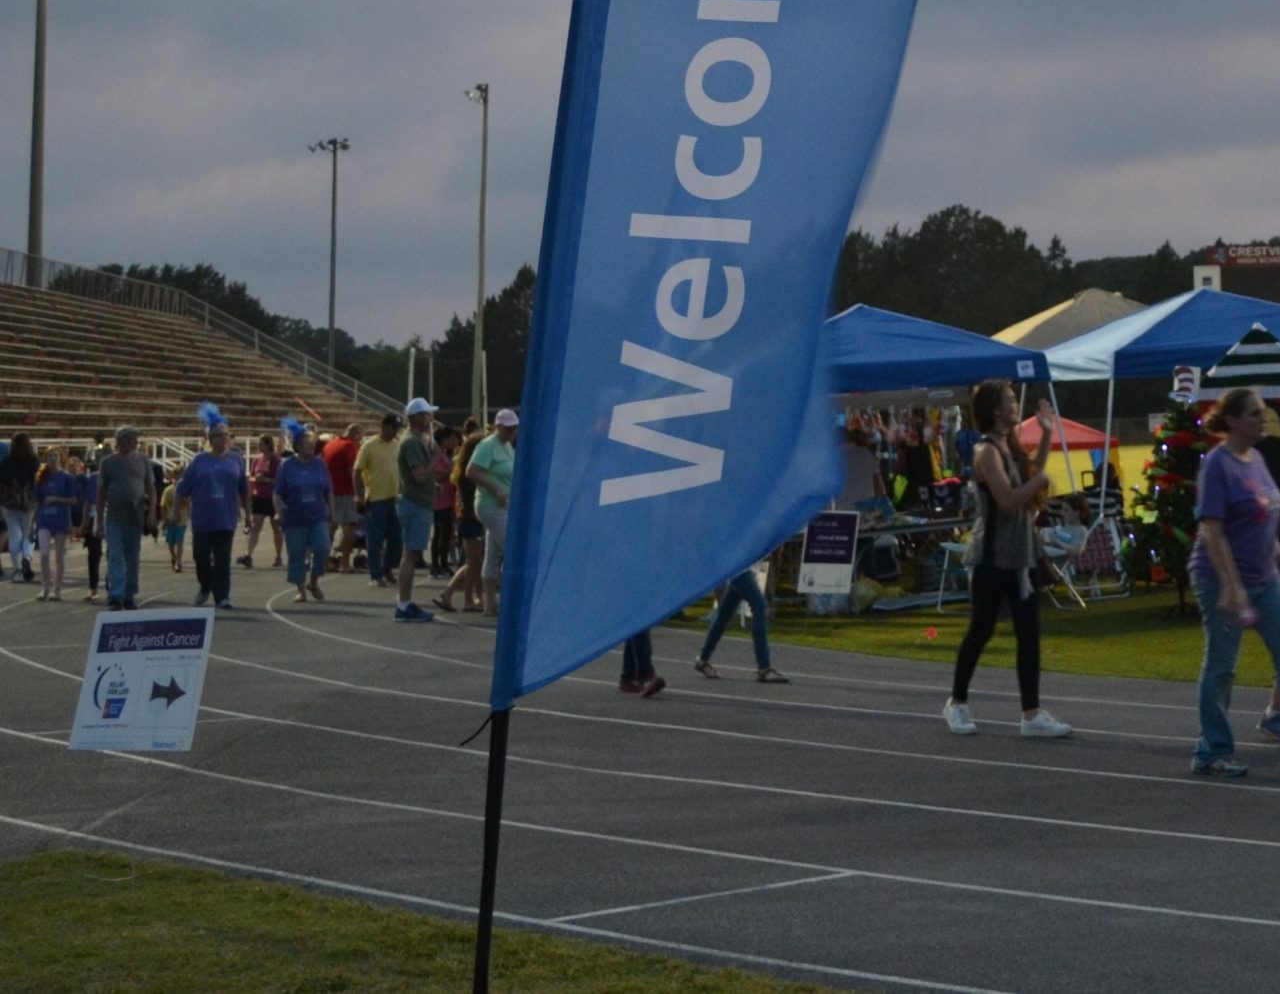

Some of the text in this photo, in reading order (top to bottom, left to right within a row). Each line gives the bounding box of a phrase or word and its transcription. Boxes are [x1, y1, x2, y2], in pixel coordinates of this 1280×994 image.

[108, 632, 201, 652] Fight Against Cancer
